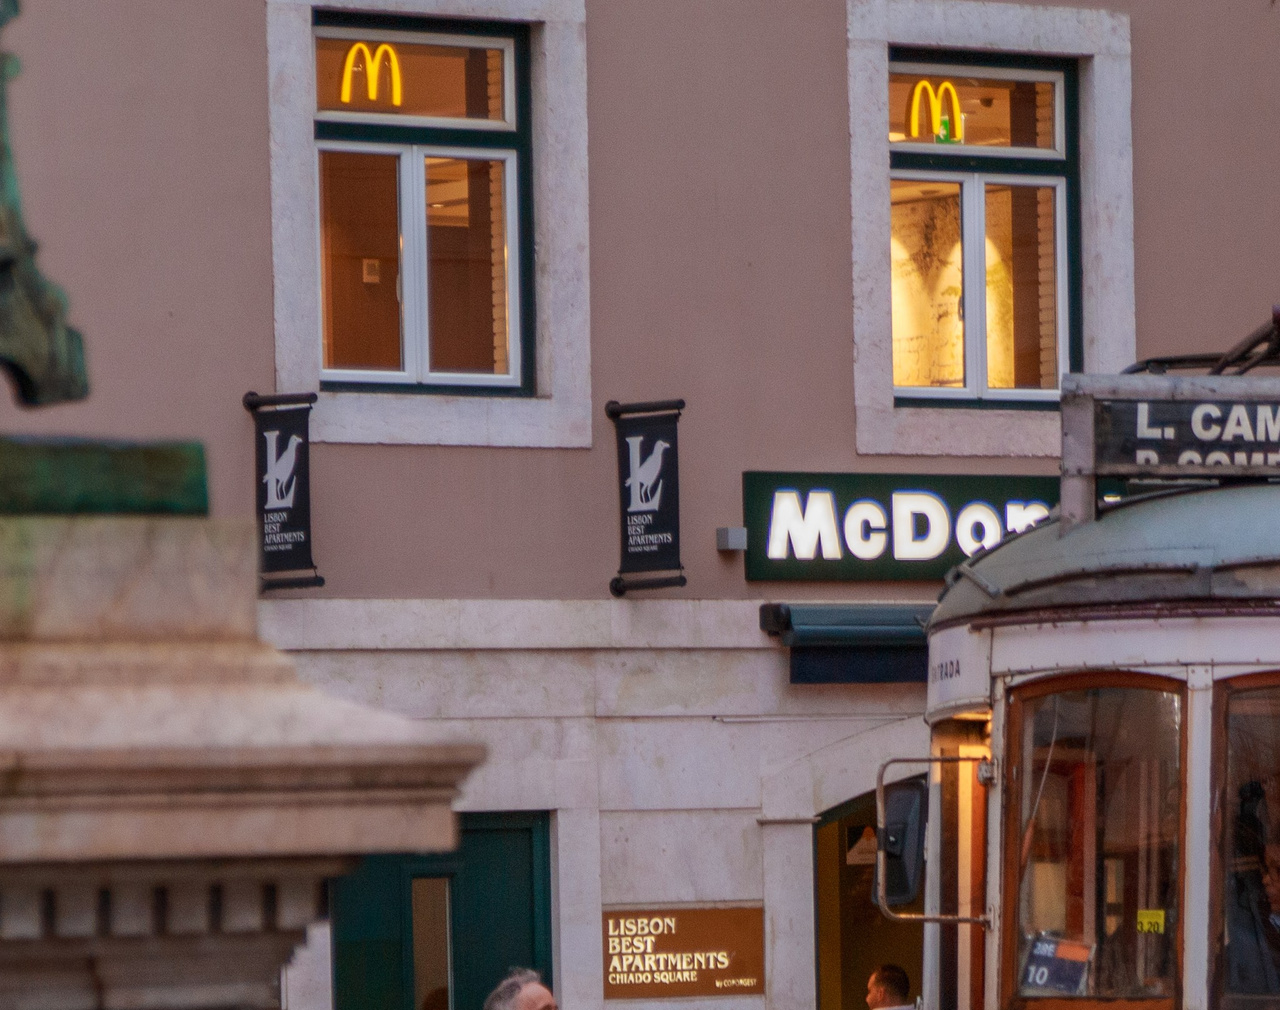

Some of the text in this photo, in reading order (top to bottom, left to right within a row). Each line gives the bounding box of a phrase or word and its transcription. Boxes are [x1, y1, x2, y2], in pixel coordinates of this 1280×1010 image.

[1136, 402, 1174, 440] L.
[264, 523, 280, 533] BEST
[627, 525, 645, 536] BEST
[264, 531, 305, 544] APARTMENTS
[628, 533, 672, 546] APARTMENTS
[608, 917, 676, 936] LISBON
[608, 936, 655, 954] BEST
[609, 952, 729, 972] APARTMENTS
[608, 971, 698, 985] CHIADO SQUARE
[1028, 965, 1049, 985] 10
